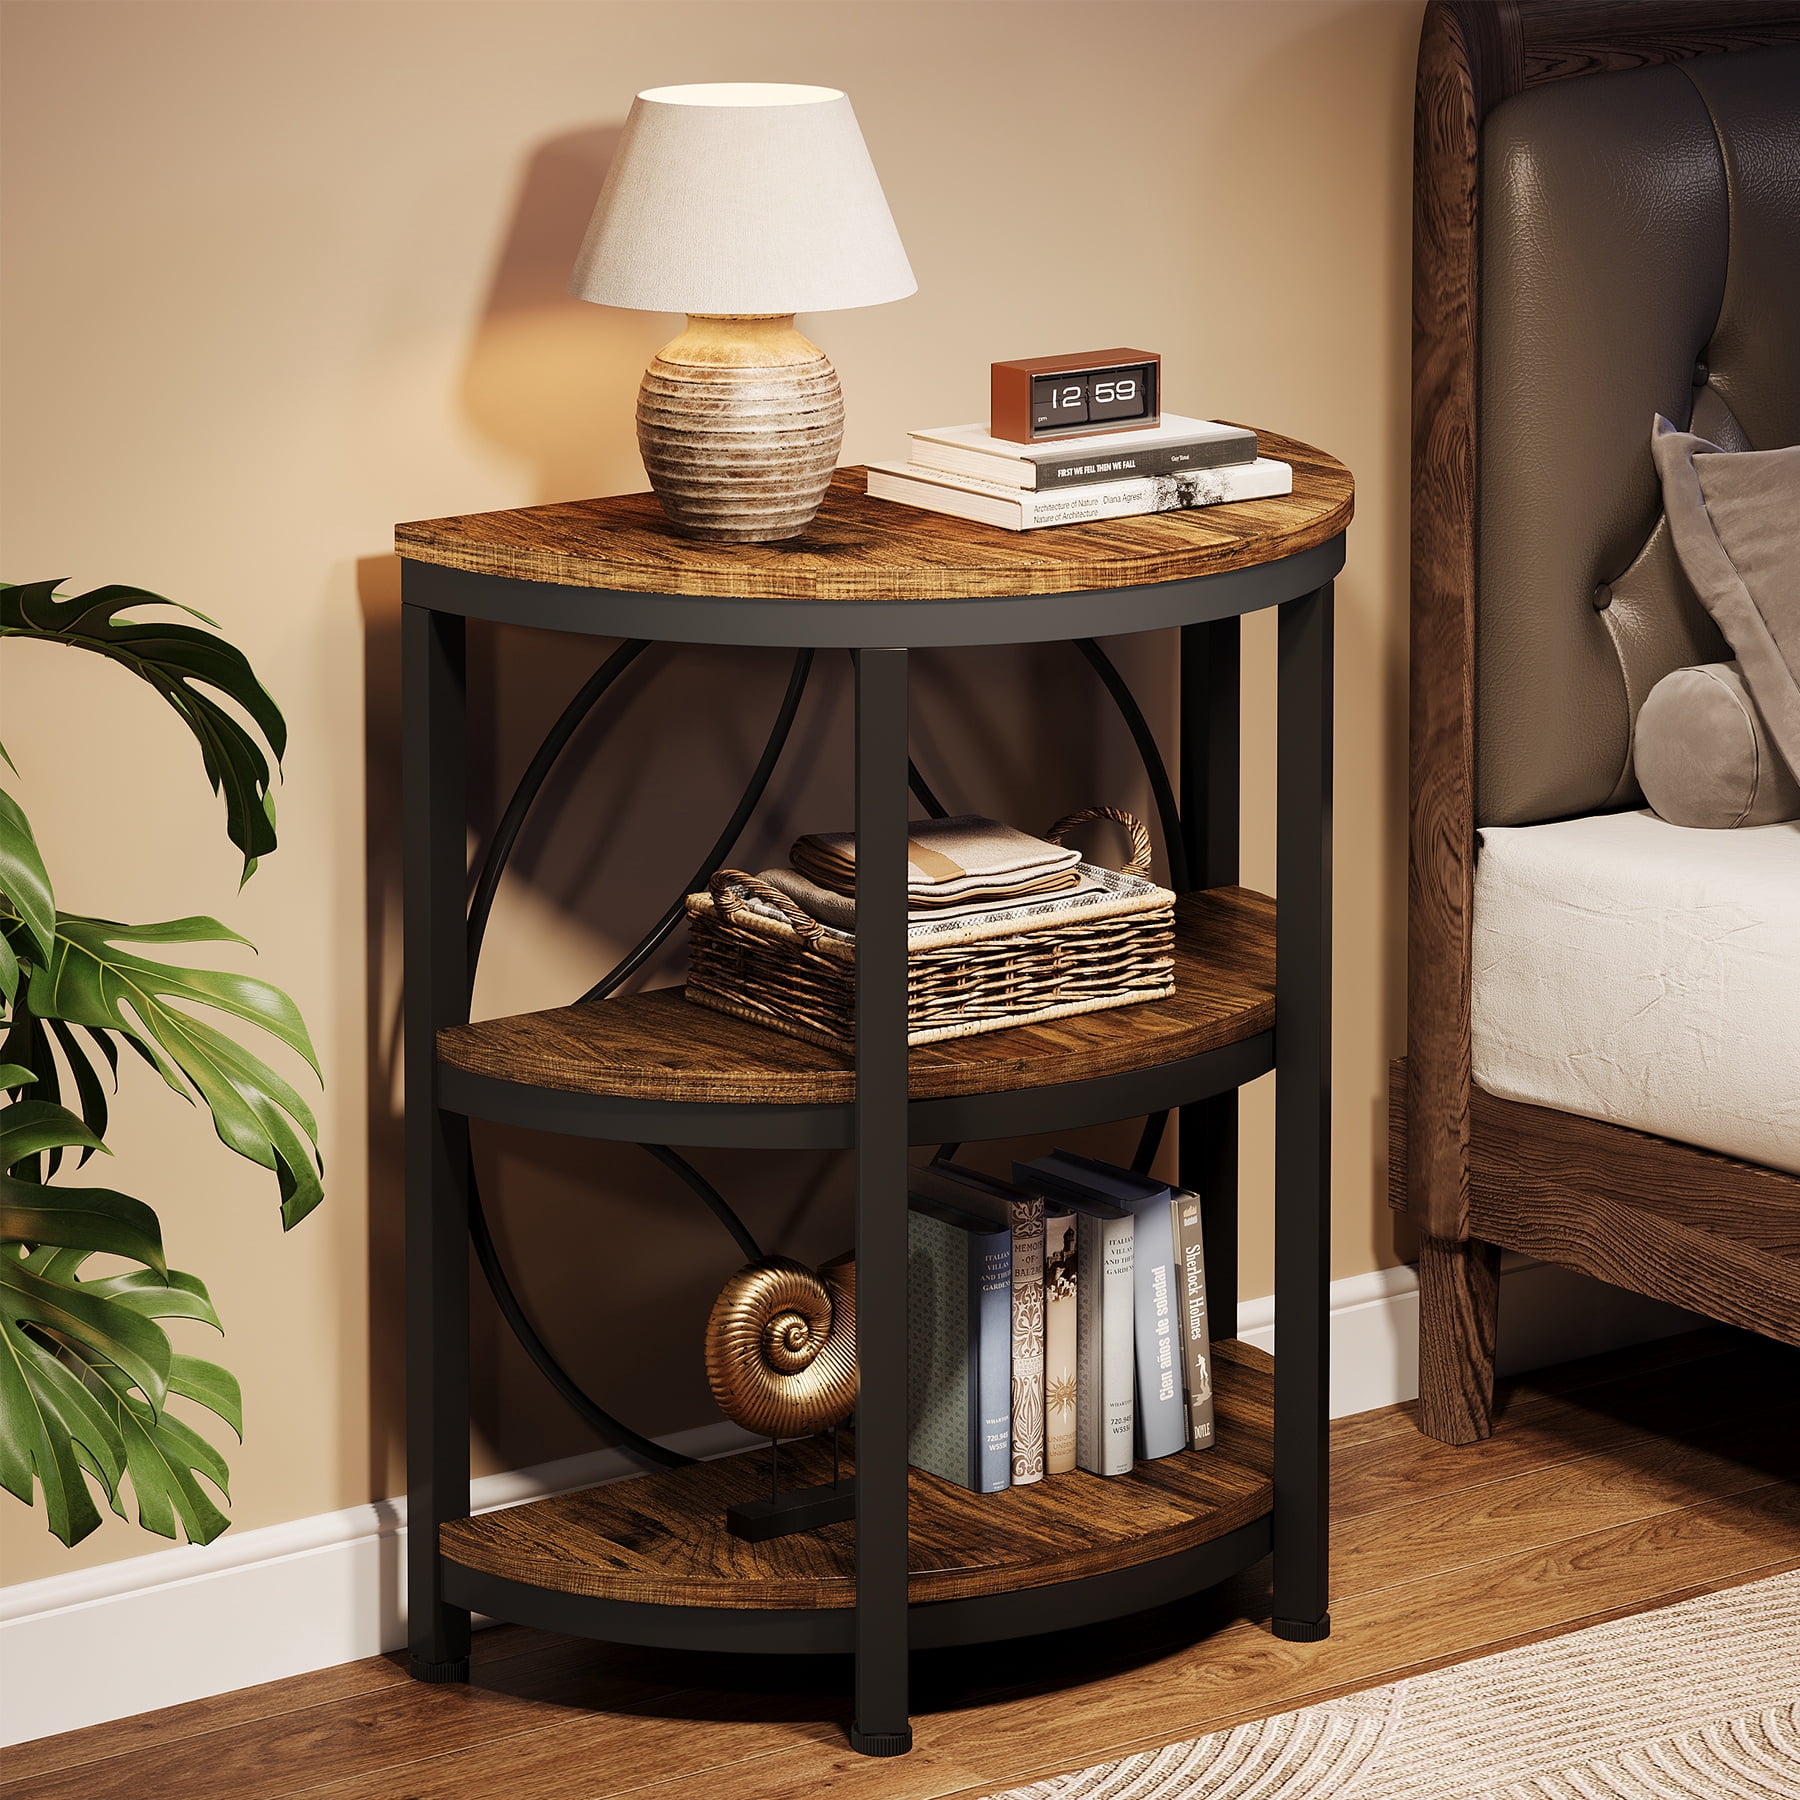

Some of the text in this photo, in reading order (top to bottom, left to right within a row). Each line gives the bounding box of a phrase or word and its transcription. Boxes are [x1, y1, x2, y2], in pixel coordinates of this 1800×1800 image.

[1052, 379, 1136, 409] 12 59
[1057, 467, 1073, 478] FIRST
[1074, 465, 1083, 475] WE
[1096, 462, 1111, 473] THEN
[1112, 461, 1122, 471] WE
[1122, 459, 1136, 470] FALL
[1034, 498, 1098, 513] Architecture of Nature
[1102, 493, 1142, 505] Diana Agrest
[1033, 509, 1098, 524] Nature of Architecture
[1104, 1258, 1120, 1266] AND
[1185, 1244, 1203, 1297] Sherlock
[980, 1272, 996, 1281] AND
[1189, 1296, 1205, 1341] Holmes
[1151, 1264, 1175, 1401] Cien años de soledad
[1194, 1422, 1211, 1440] DOYLE
